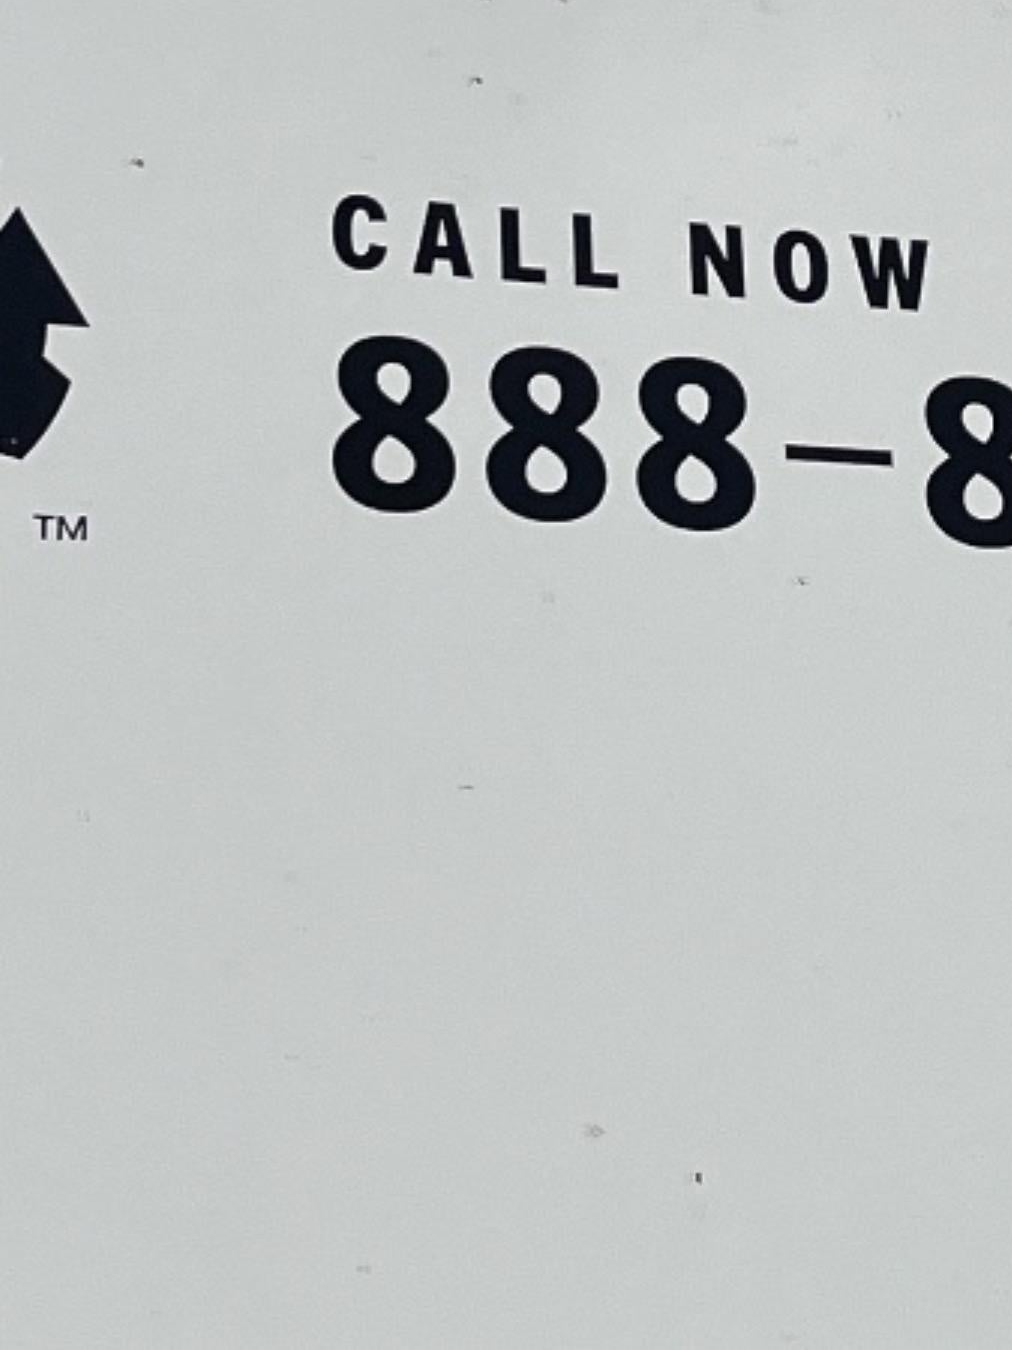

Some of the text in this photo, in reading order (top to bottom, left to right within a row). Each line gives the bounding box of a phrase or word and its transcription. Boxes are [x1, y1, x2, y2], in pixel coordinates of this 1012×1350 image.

[332, 195, 928, 311] CALL NOW
[33, 514, 87, 541] TM
